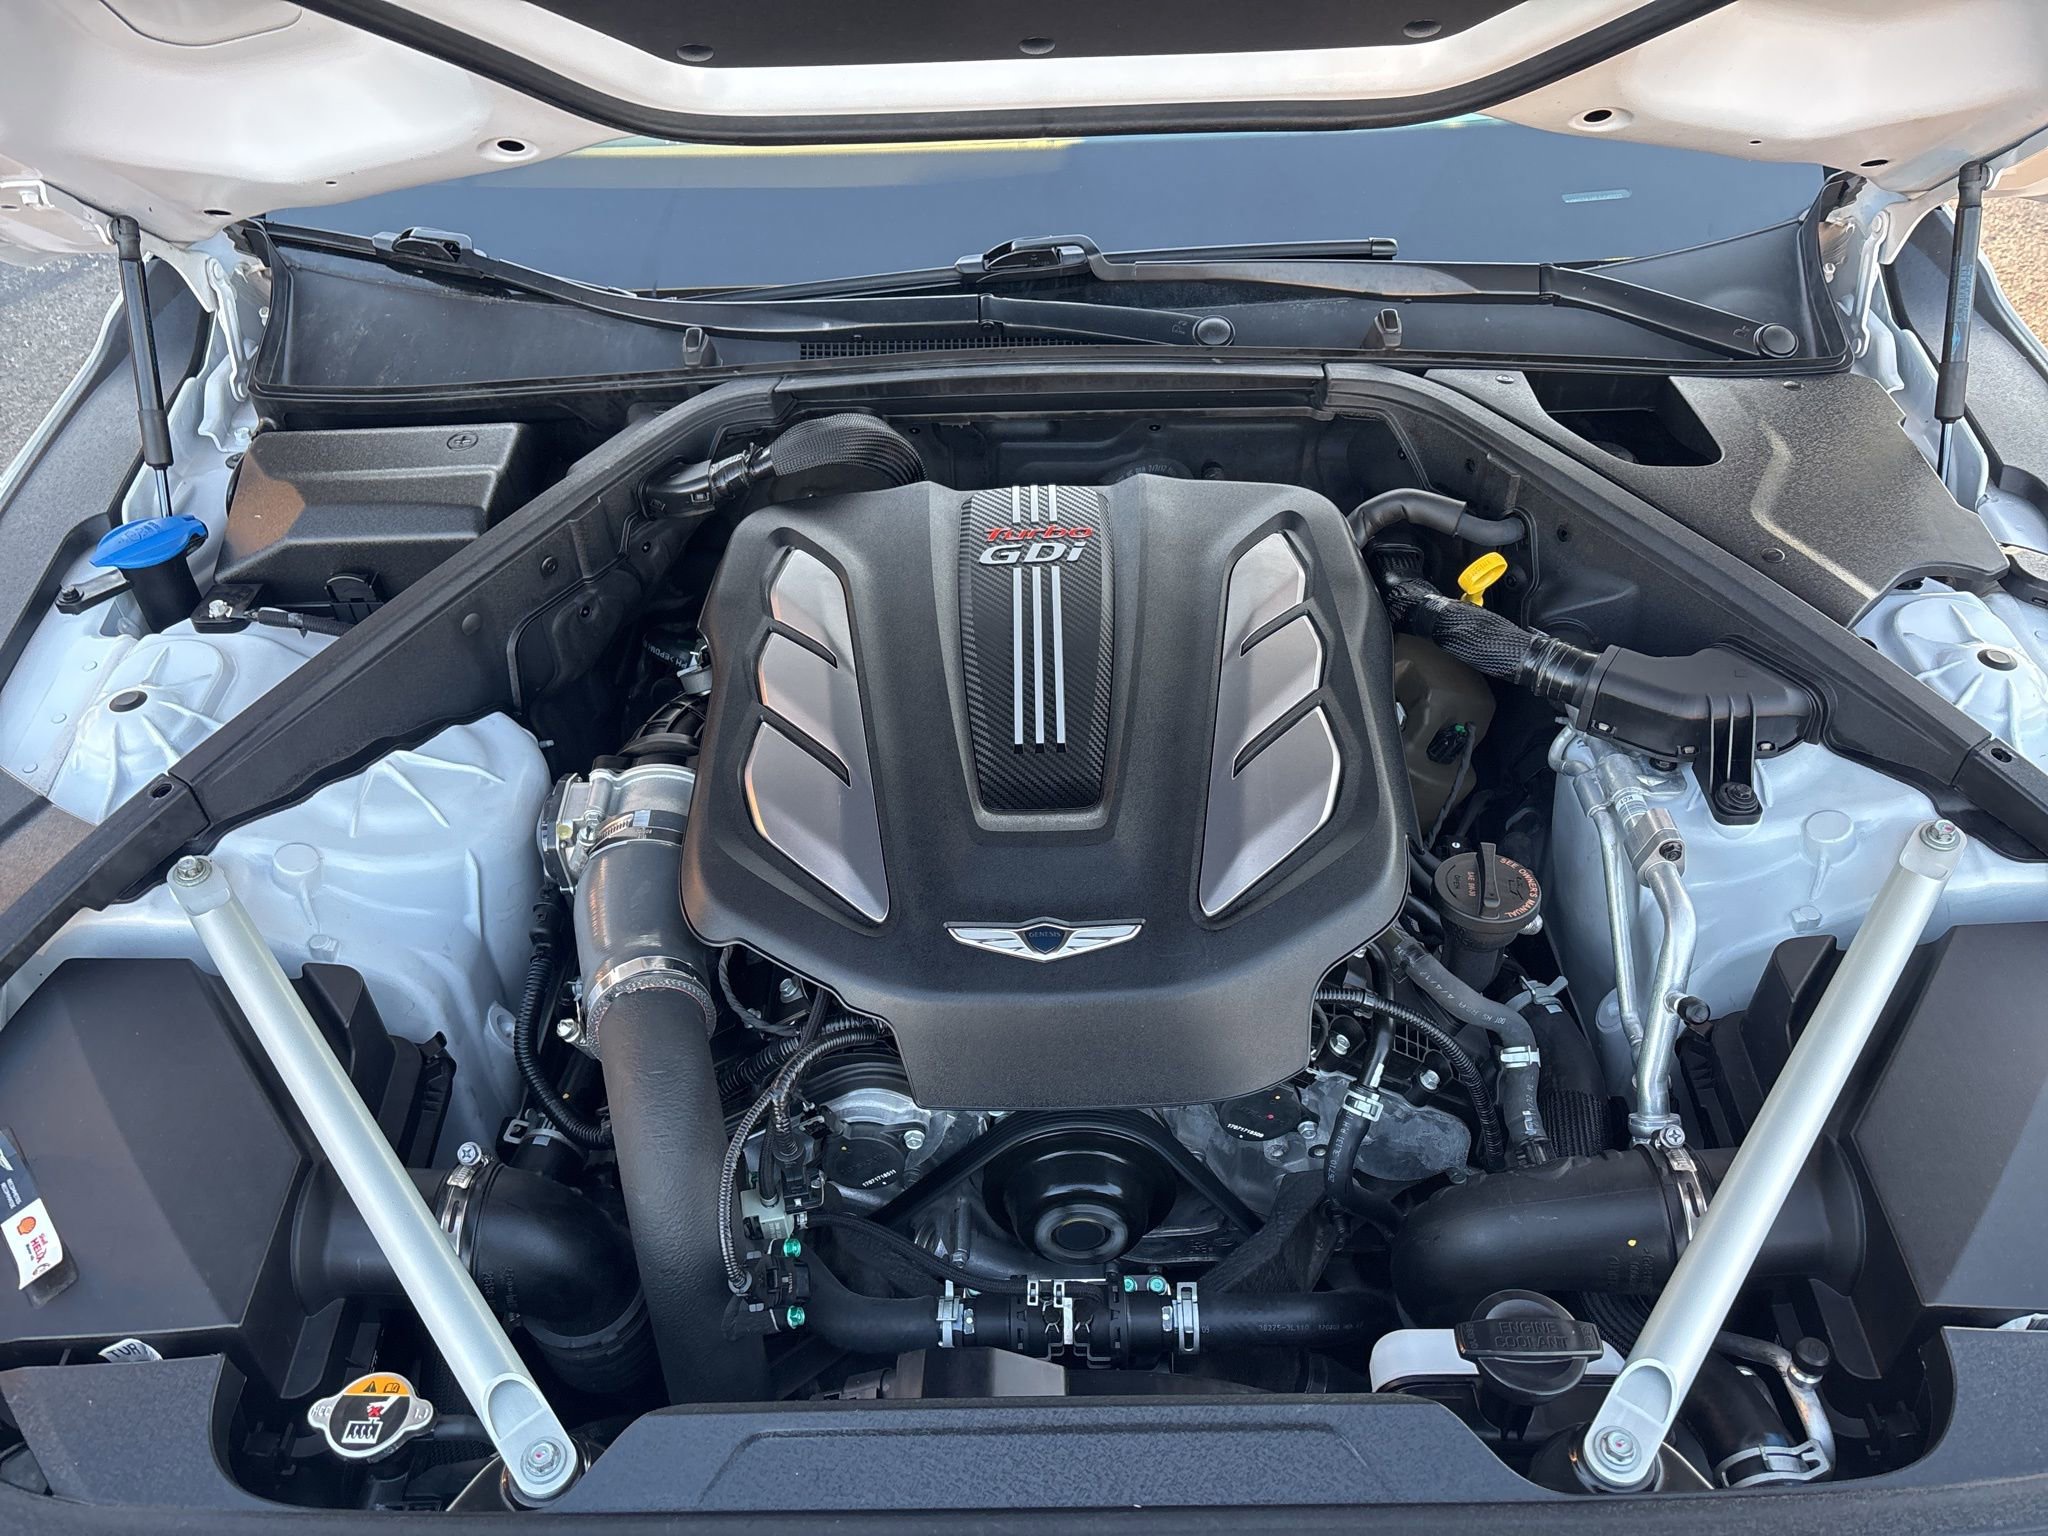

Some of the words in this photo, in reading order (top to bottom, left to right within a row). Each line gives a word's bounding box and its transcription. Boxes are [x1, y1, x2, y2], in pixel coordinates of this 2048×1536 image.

[984, 524, 1093, 542] Turbo
[979, 541, 1087, 565] GDi
[1500, 858, 1518, 869] SEE
[1519, 868, 1538, 898] OWNER'S
[1504, 898, 1536, 918] MANUAL
[30, 1237, 47, 1264] HELIX
[1498, 1321, 1558, 1334] ENGINE
[1494, 1335, 1568, 1349] COOLANT
